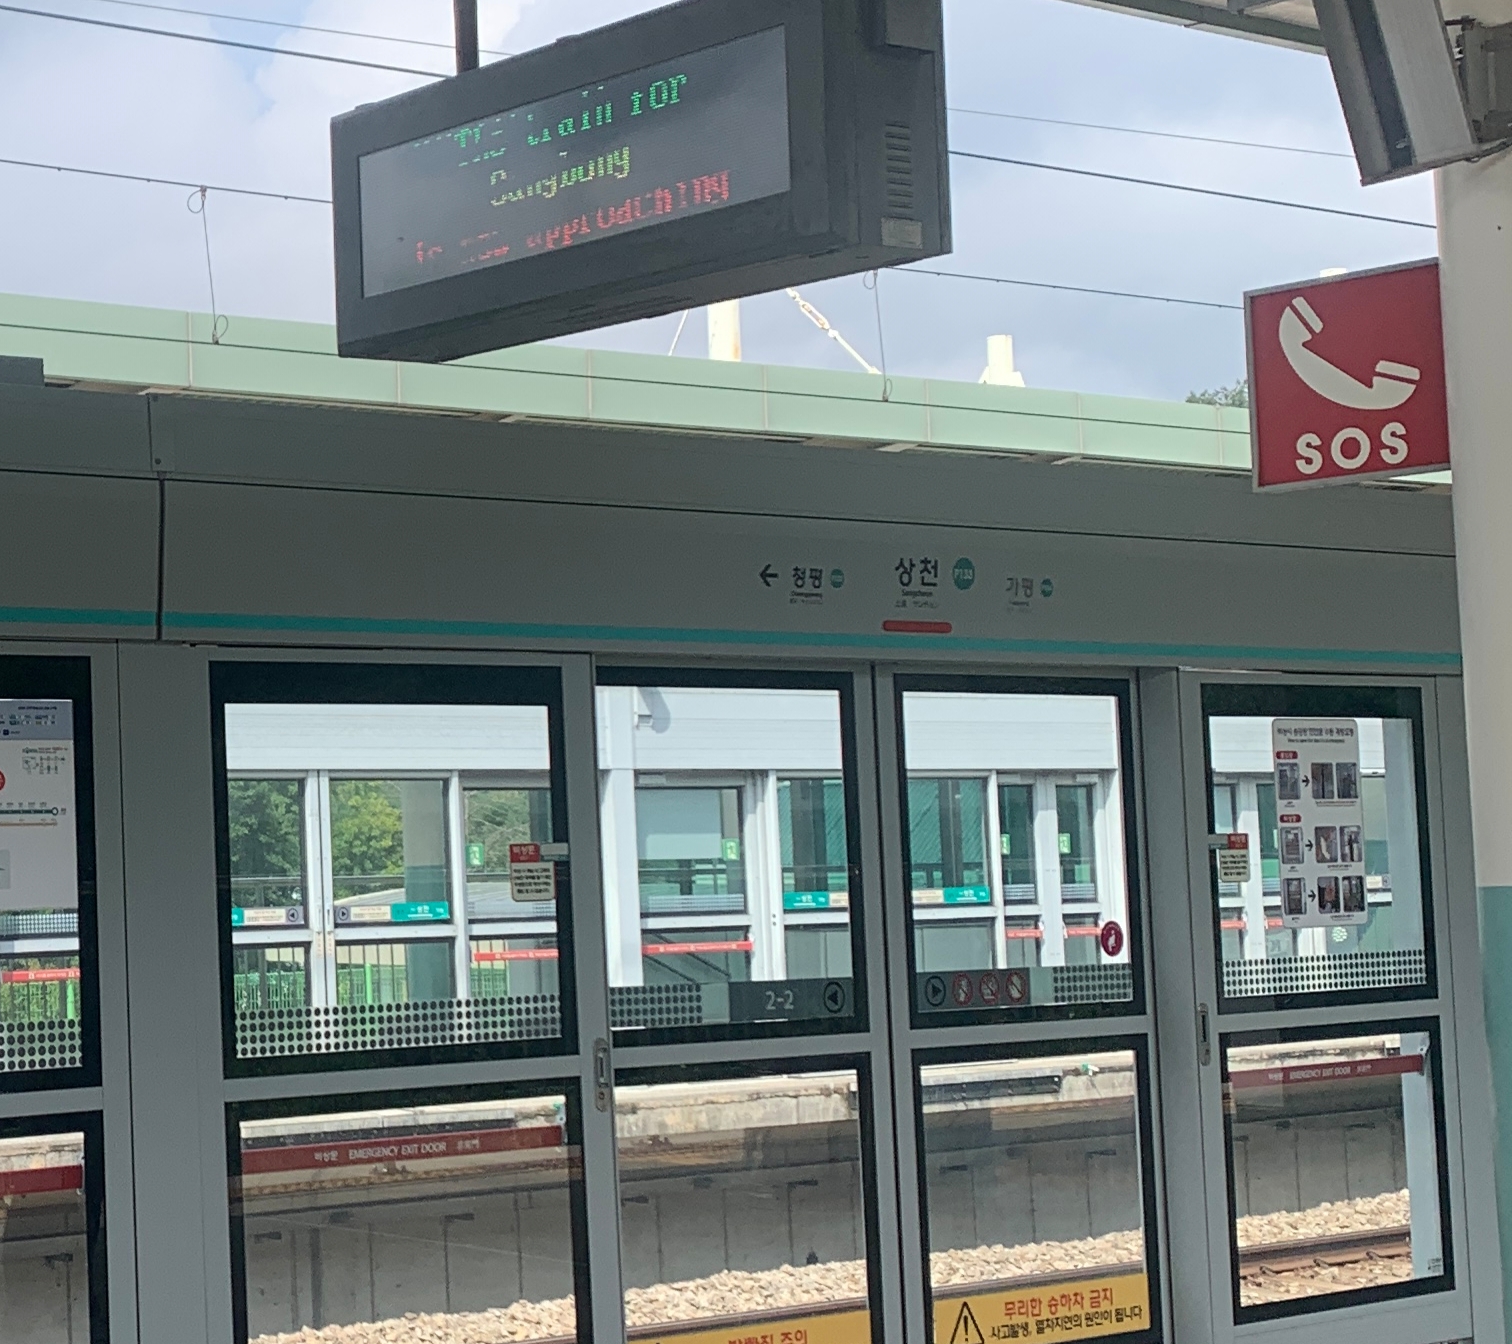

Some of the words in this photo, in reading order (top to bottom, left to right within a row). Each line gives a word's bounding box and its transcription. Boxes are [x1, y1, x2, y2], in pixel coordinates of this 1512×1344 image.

[1295, 421, 1409, 475] SOS
[792, 566, 823, 589] 청평
[895, 557, 938, 587] 상천
[766, 990, 794, 1010] 2-2
[349, 1146, 398, 1160] EMERGENCY
[401, 1144, 419, 1155] EXIT
[420, 1142, 446, 1153] DOOR
[1004, 1297, 1043, 1320] 무리한
[1047, 1291, 1085, 1315] 승하차
[1090, 1288, 1114, 1309] 금지
[1036, 1314, 1083, 1334] 열차지연의
[1084, 1309, 1113, 1327] 원인이
[1114, 1305, 1143, 1323] 됩니다
